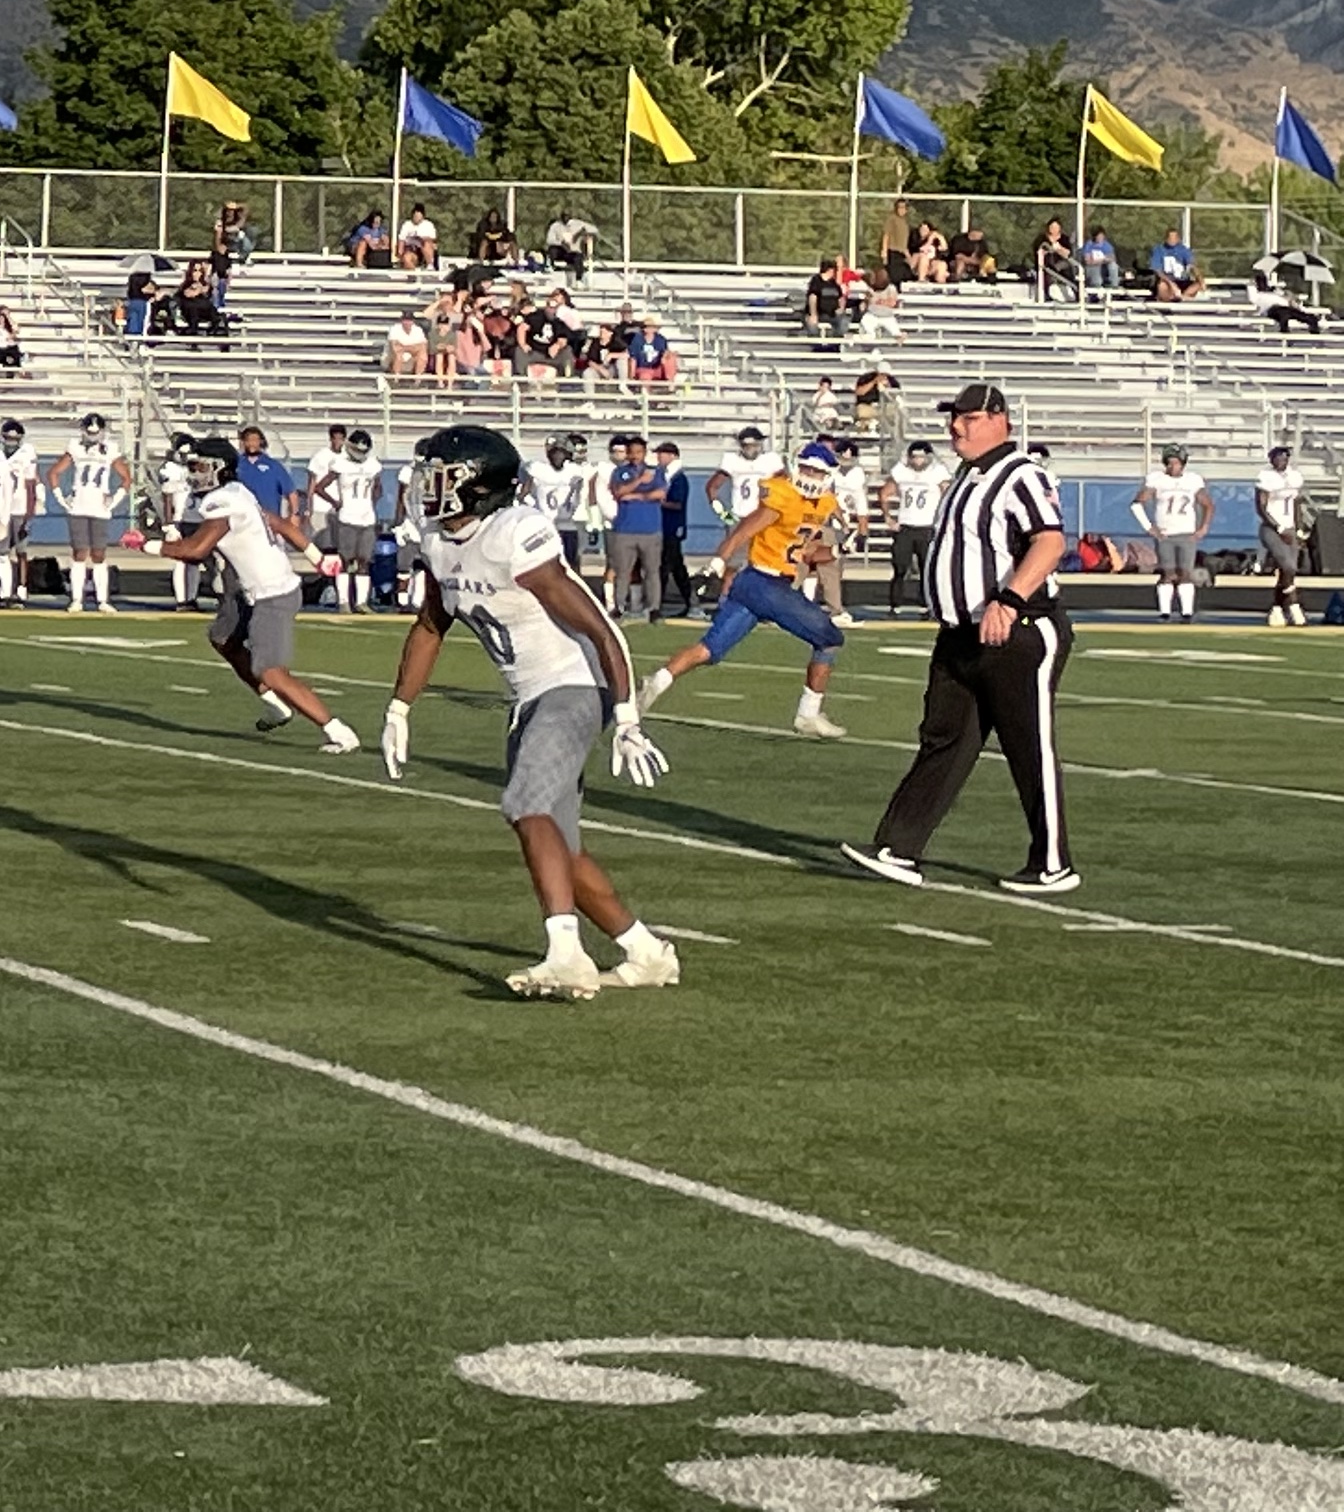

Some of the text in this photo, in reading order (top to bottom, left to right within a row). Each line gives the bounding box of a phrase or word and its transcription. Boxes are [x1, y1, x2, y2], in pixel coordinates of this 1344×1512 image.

[740, 478, 751, 500] 6
[904, 487, 928, 510] 66
[1166, 494, 1191, 516] 12
